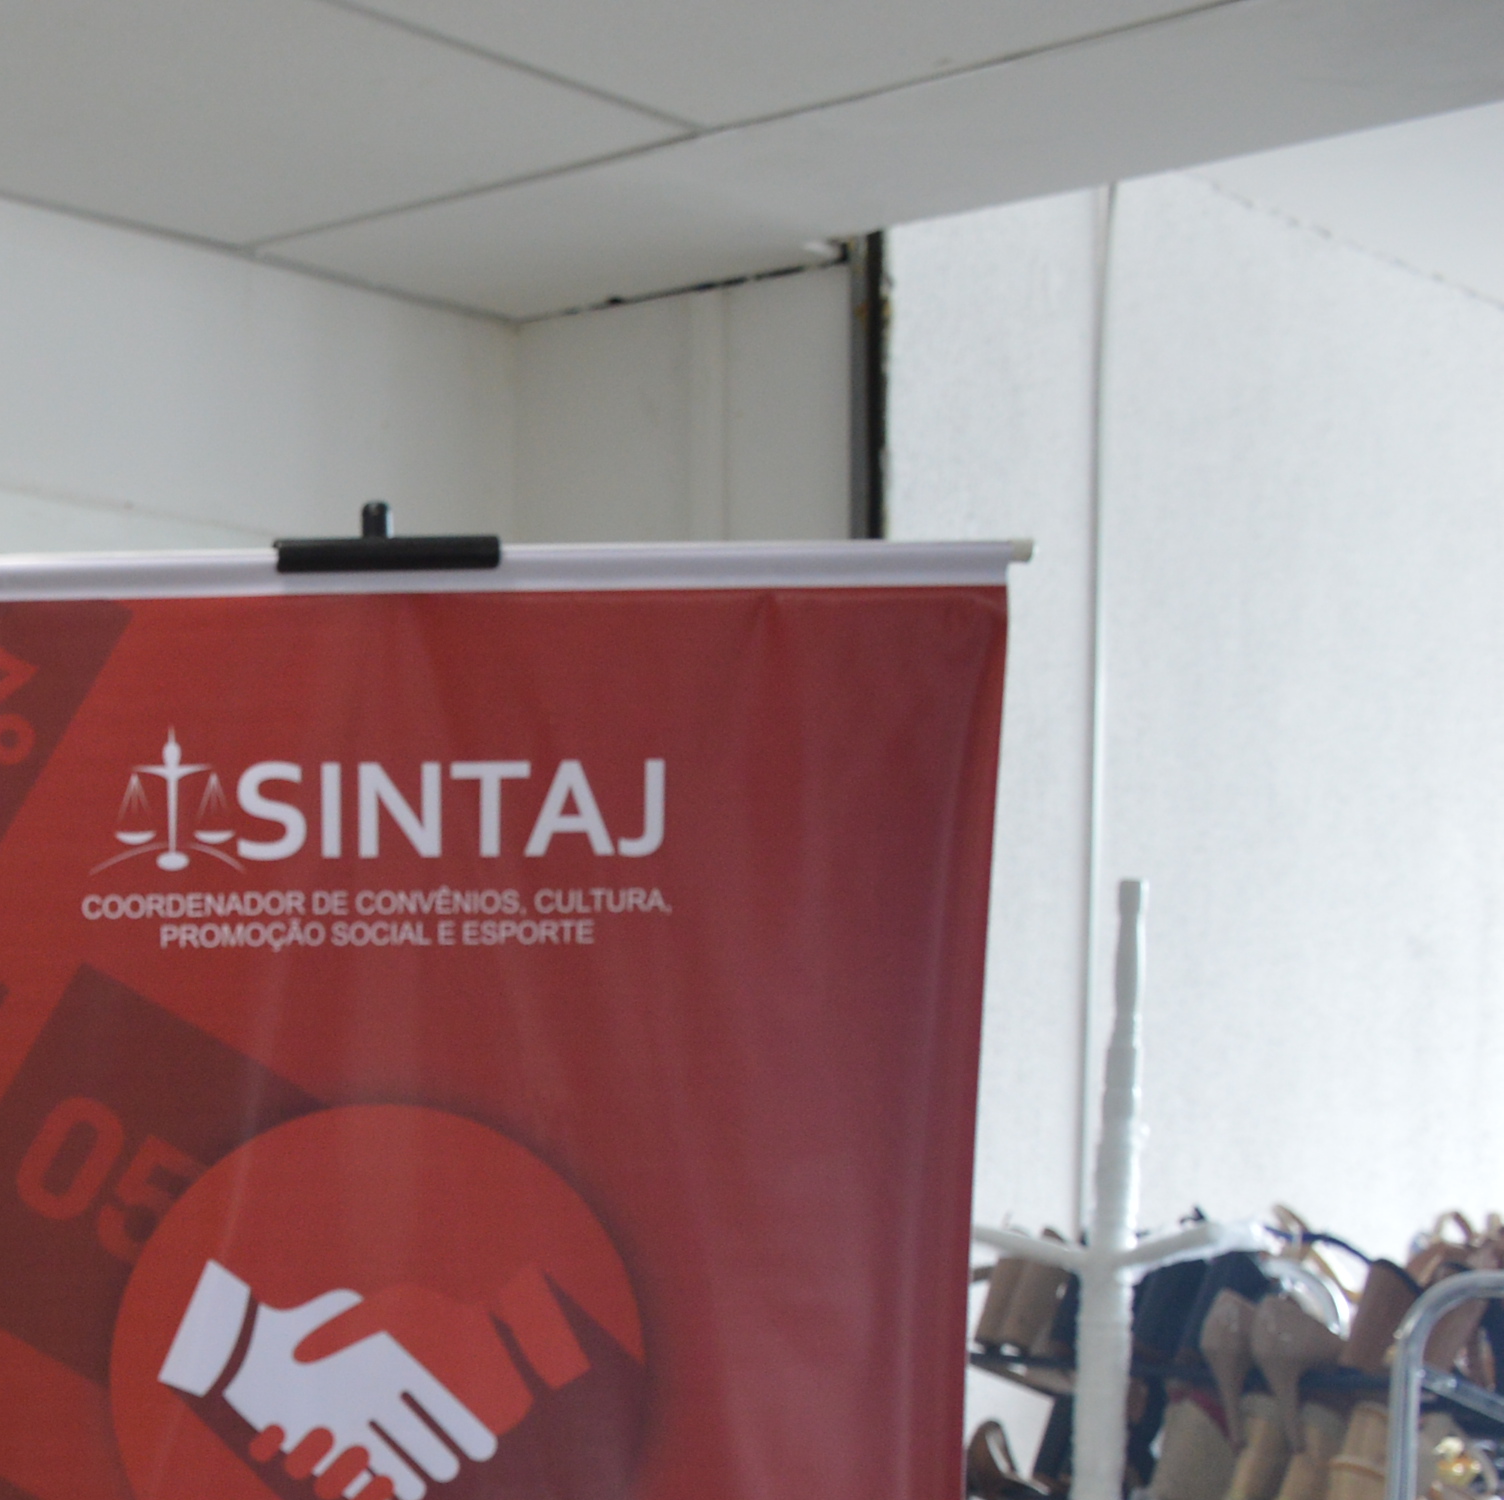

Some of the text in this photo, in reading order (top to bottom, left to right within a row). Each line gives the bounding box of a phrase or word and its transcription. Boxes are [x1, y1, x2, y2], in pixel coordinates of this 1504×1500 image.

[235, 757, 667, 862] SINTAJ
[81, 884, 673, 920] COORDENADOR DE CONVÊNIOS, CULTURA,
[159, 917, 595, 953] PROMOÇÃO SOCIAL E ESPORTE
